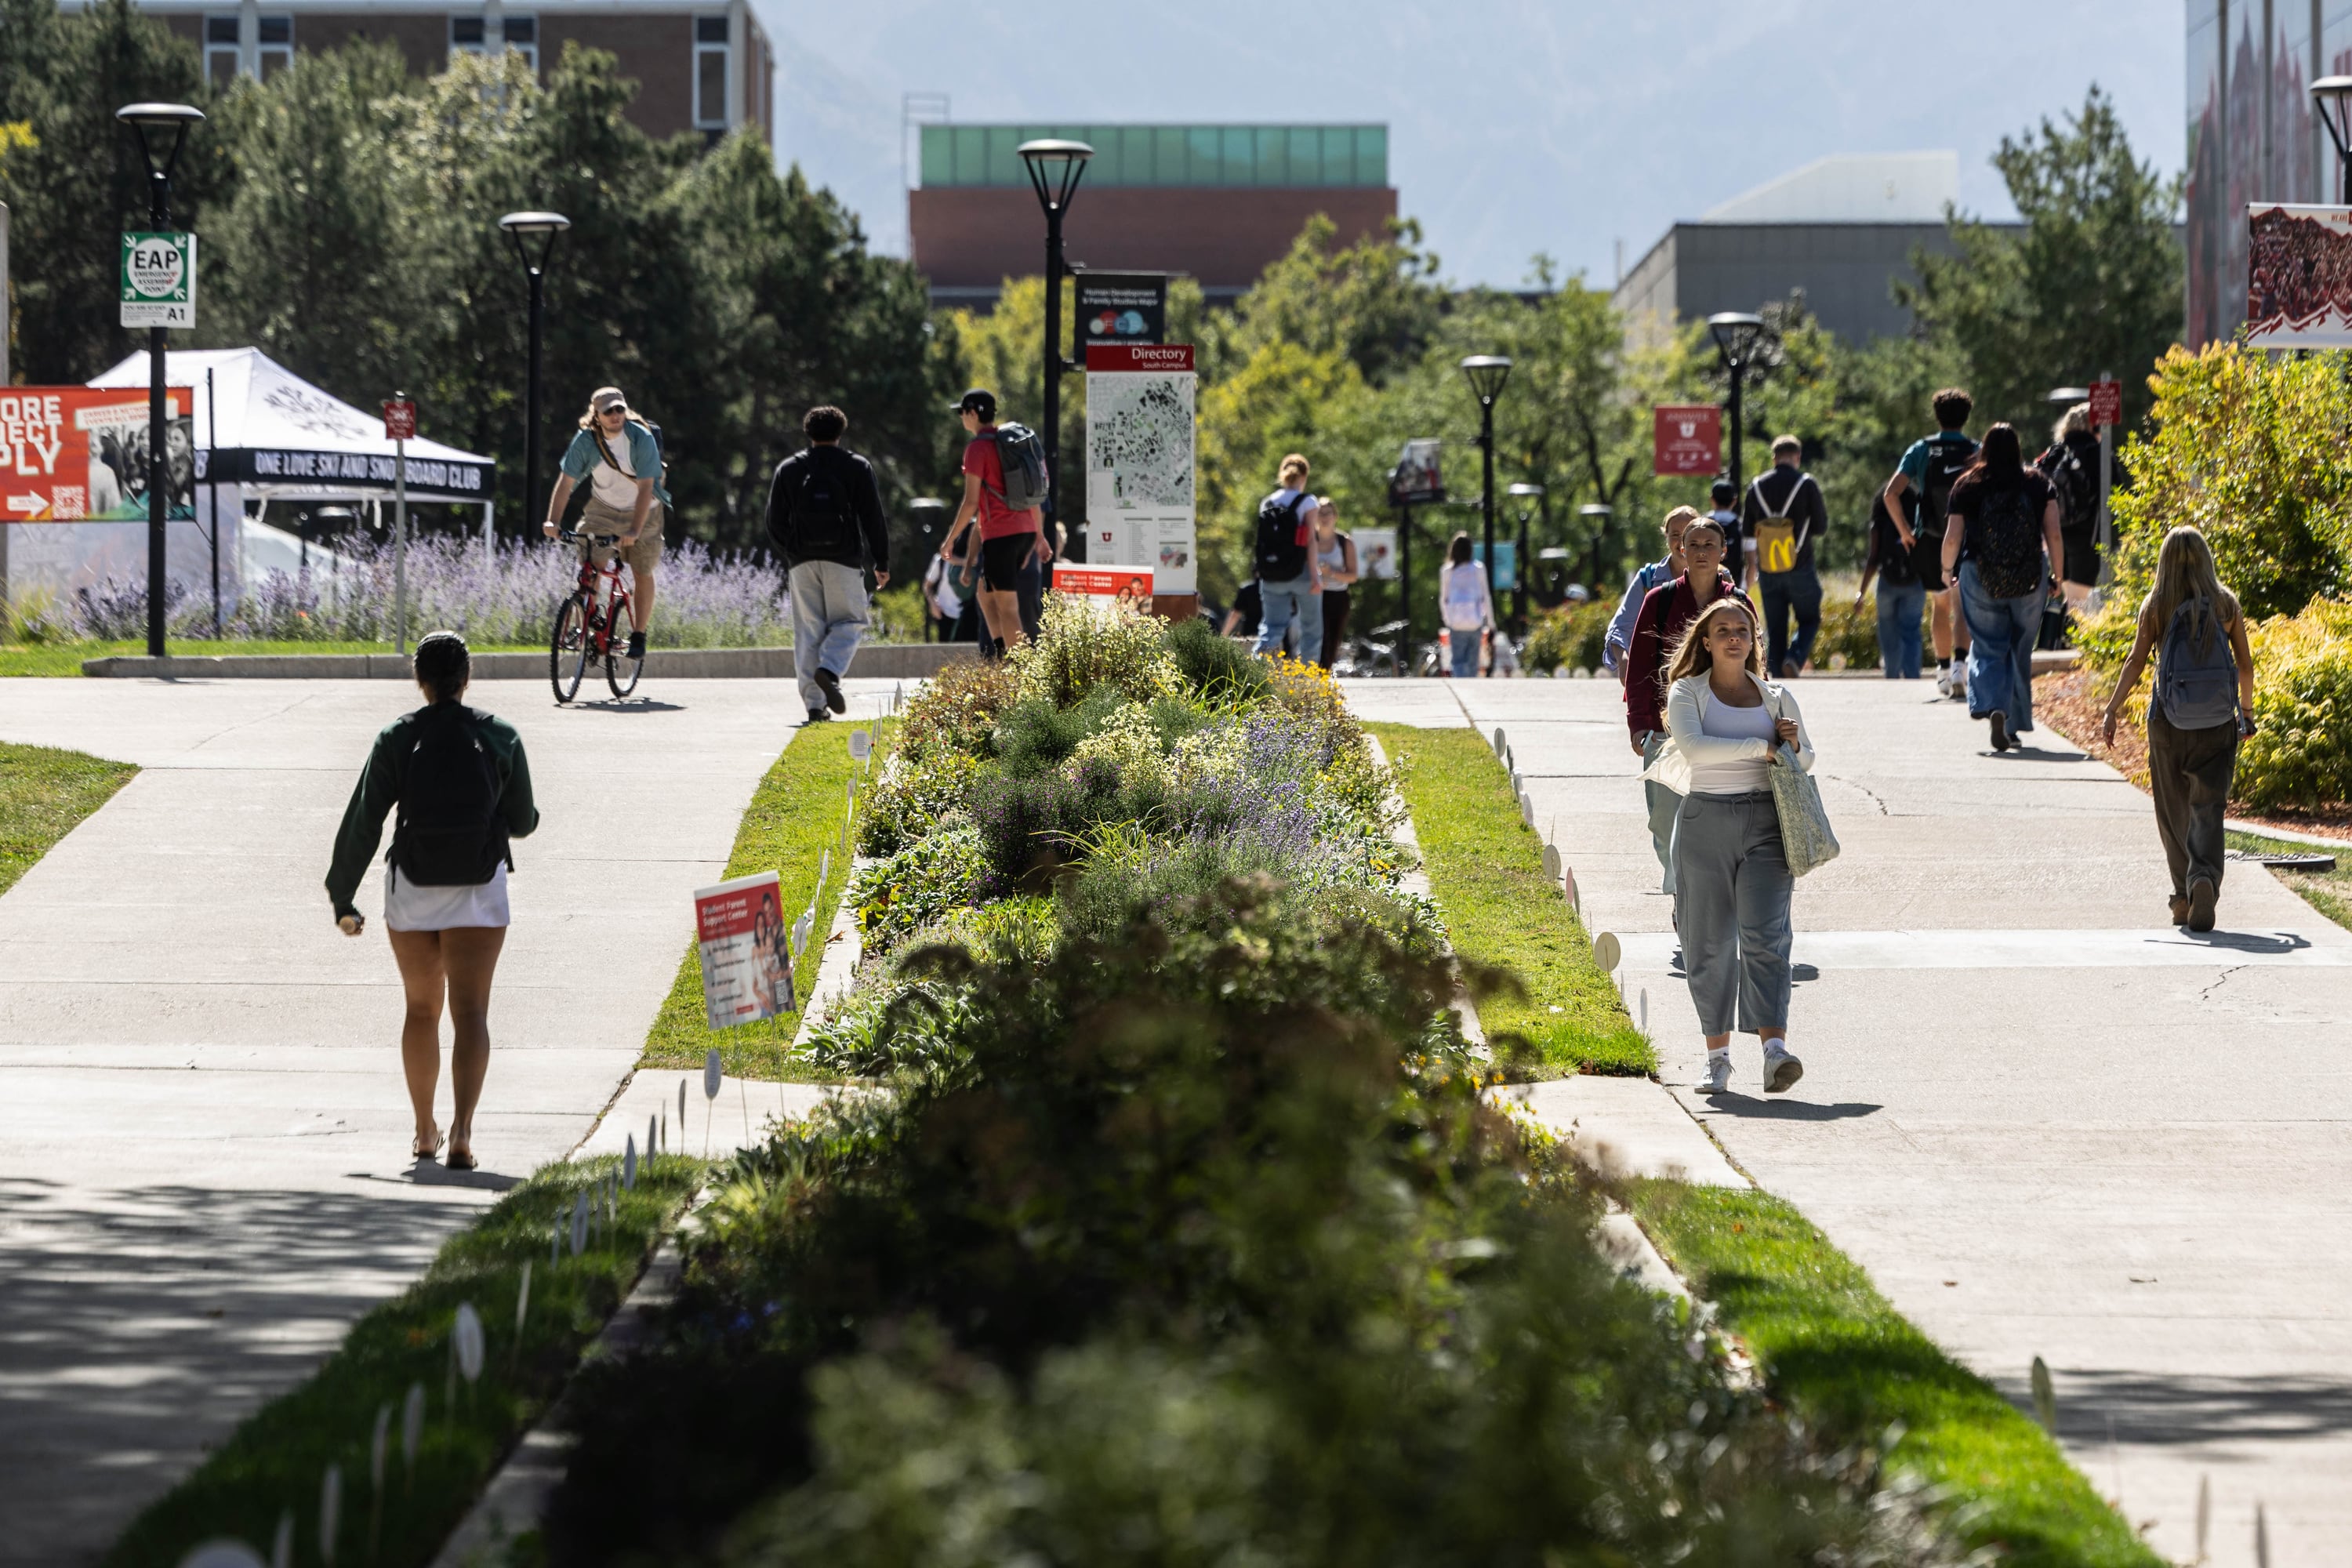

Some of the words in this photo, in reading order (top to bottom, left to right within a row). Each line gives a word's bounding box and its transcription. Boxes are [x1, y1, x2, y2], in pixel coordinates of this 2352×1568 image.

[134, 250, 178, 269] EAP
[1111, 289, 1156, 298] Development
[167, 307, 185, 321] A1
[1131, 347, 1186, 361] Directory
[0, 395, 62, 423] ORE
[255, 451, 281, 474] ONE
[283, 452, 316, 477] LOVE
[317, 452, 339, 477] SKI
[340, 456, 368, 479] AND
[369, 456, 447, 486] SNOBOARD
[448, 464, 481, 490] CLUB
[727, 898, 746, 909] Parent
[704, 913, 727, 927] Support
[728, 909, 748, 920] Center
